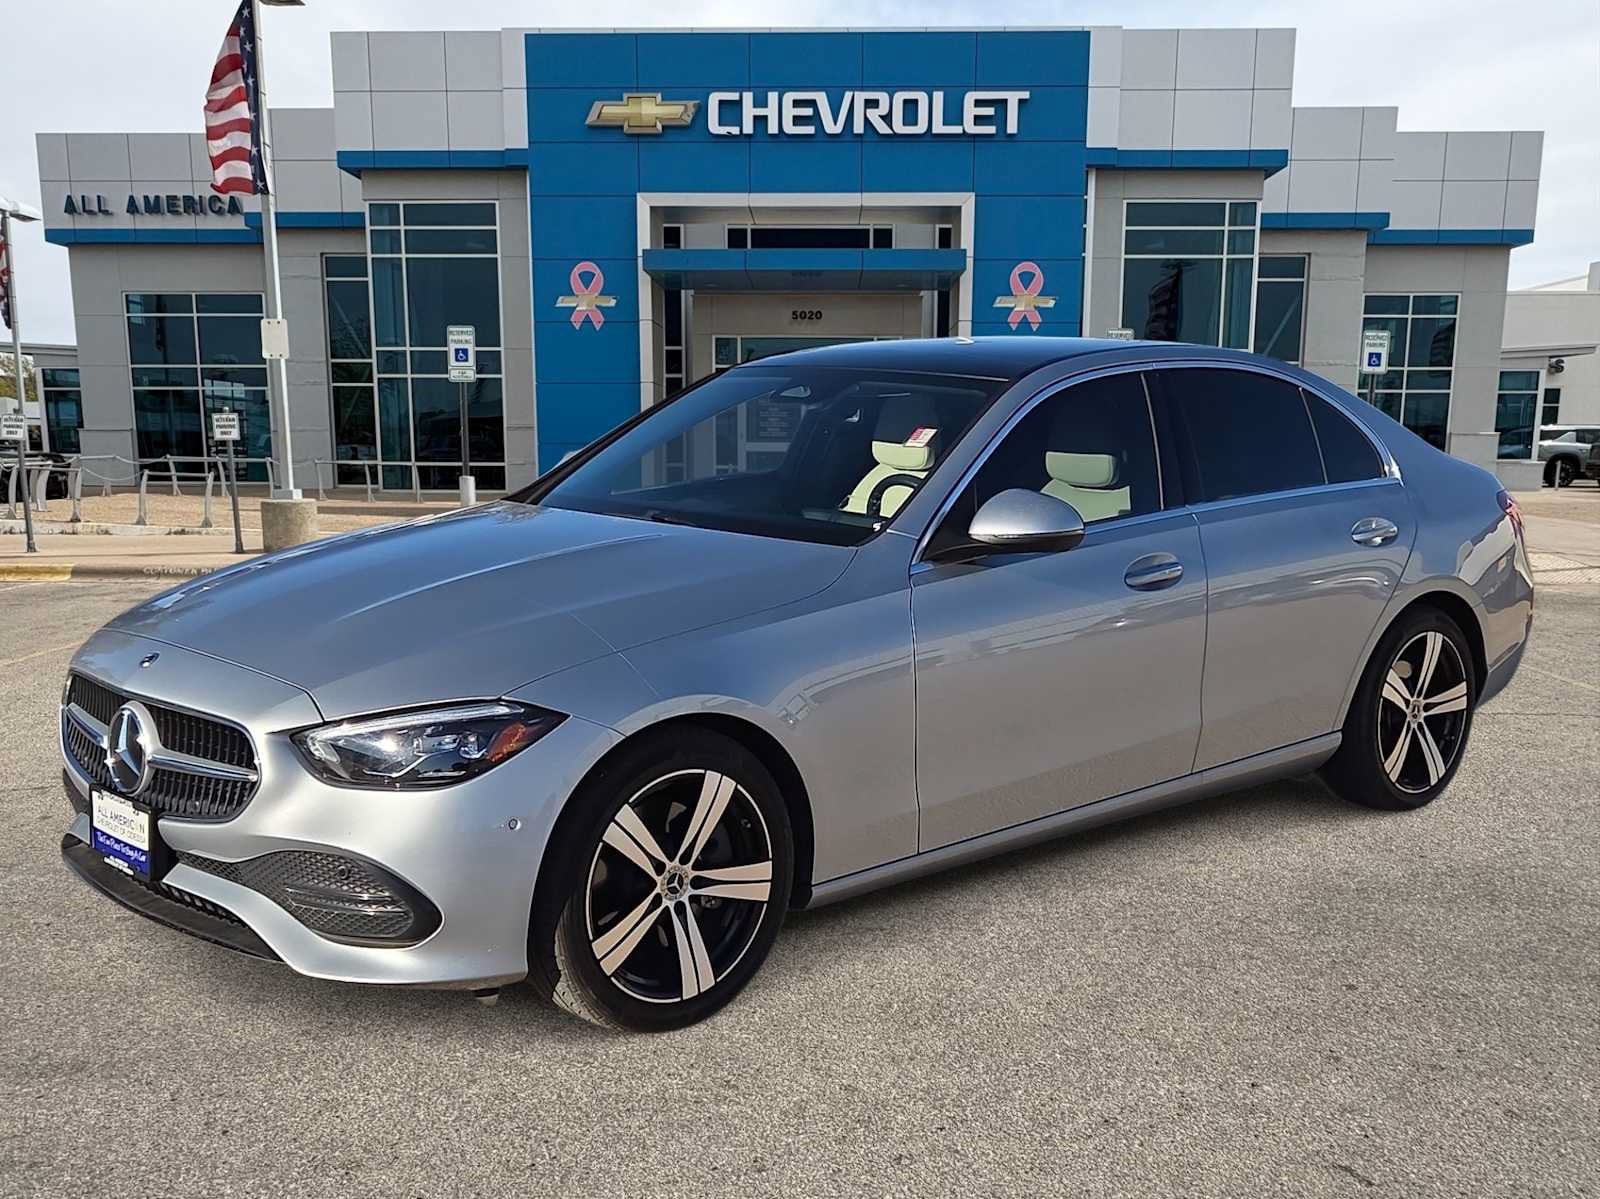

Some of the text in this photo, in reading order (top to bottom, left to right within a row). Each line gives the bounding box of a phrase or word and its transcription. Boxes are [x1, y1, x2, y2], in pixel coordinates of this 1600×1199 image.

[707, 90, 1031, 135] CHEVROLET
[64, 194, 243, 216] ALL AMERICA
[791, 310, 823, 320] 5020
[109, 809, 145, 834] AMERICN
